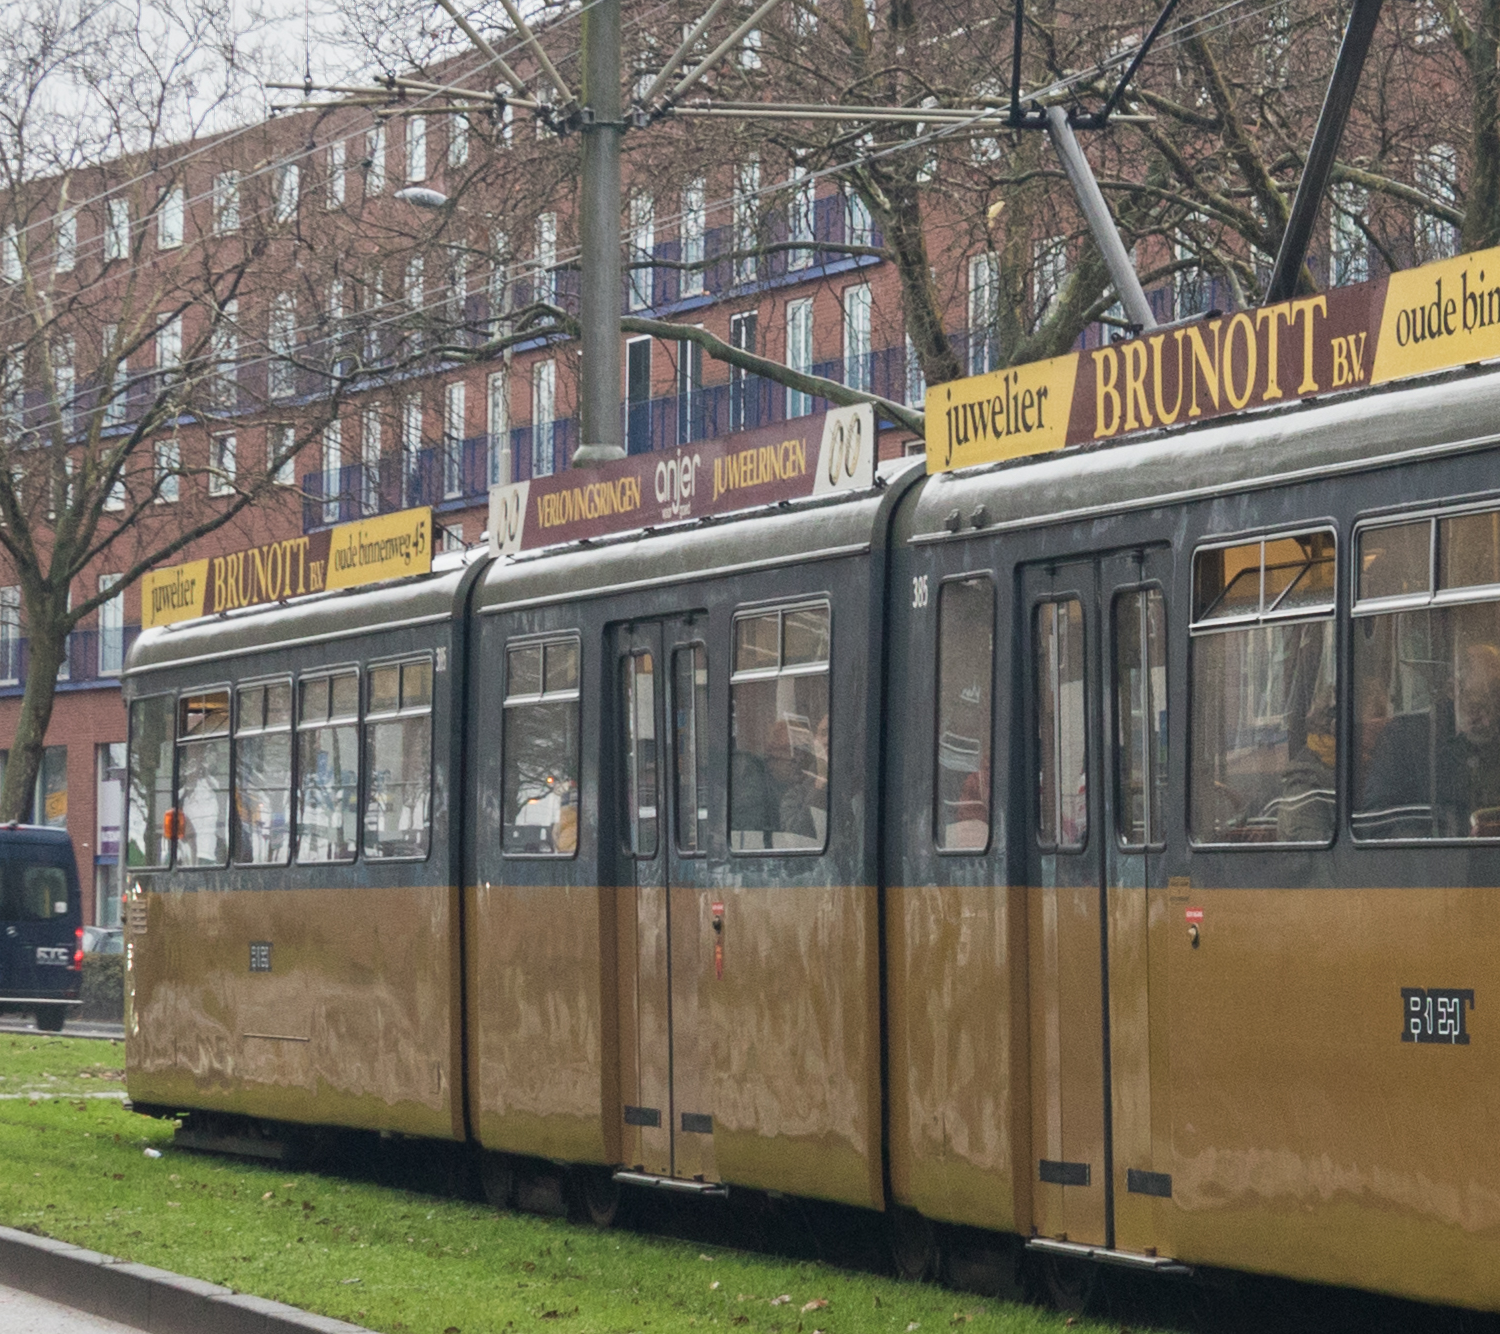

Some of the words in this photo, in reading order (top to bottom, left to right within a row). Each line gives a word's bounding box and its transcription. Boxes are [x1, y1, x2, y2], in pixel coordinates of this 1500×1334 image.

[945, 372, 1048, 466] juwelier
[1092, 295, 1327, 439] BRUNOTT
[1331, 331, 1366, 388] B.V.
[1396, 277, 1457, 347] oude
[537, 475, 642, 529] VERLOVINGSRINGEN
[655, 449, 701, 514] anjer
[712, 438, 807, 501] JUWEELRINGEN
[151, 569, 196, 624] juwelier
[213, 536, 310, 613] BRUNOTT
[334, 533, 358, 572] oude
[412, 521, 426, 557] 45
[912, 575, 928, 608] 385
